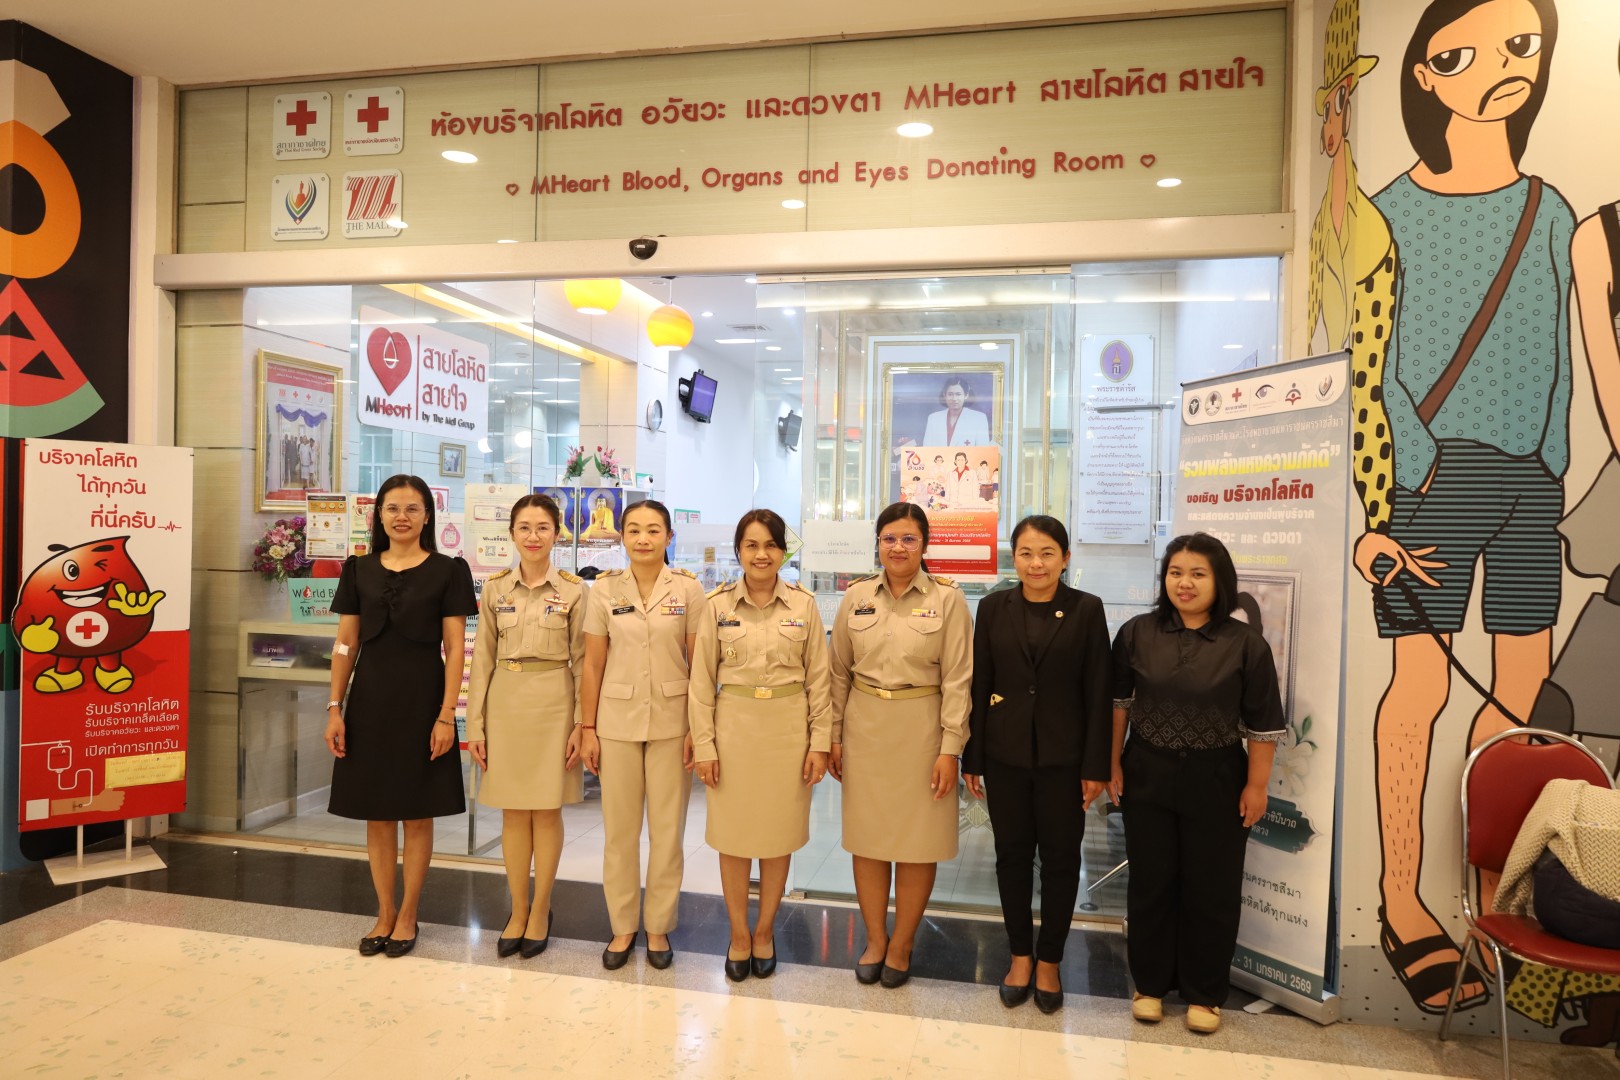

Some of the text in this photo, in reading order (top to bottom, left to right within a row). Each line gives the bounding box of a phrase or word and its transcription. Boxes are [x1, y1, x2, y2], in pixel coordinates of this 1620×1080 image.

[430, 56, 1265, 137] ห้องบริจาคโลหิต อวัยวะ และดวงตา MHeart สายโลหิต สายใจ
[530, 146, 1124, 196] MHeart Blood, Organs and Eyes Donating Room
[346, 221, 364, 231] THE
[422, 347, 486, 383] สายโลหิต
[365, 394, 412, 420] MHeart
[421, 383, 468, 412] สายใจ
[421, 411, 431, 423] by
[433, 413, 444, 424] The
[457, 418, 476, 431] Group
[39, 447, 138, 469] บริจาคโลหิต
[76, 473, 147, 499] ได้ทุกวัน
[1186, 477, 1314, 505] ขอเชิญ บริจาคโลหิต
[90, 503, 156, 529] ที่นี่ครับ
[1240, 533, 1257, 545] และ
[1262, 531, 1303, 545] ดวงตา
[85, 696, 180, 717] รับบริจาคโลหิต
[84, 723, 180, 738] รับบริจาคอวัยวะ และดวงตา
[85, 712, 180, 728] รับบริจาคเกล็ดเลือด
[85, 738, 179, 757] เปิดทำการทุกวัน
[1241, 871, 1302, 900] นครราชสีมา
[1243, 955, 1252, 970] 31
[1256, 962, 1287, 984] มกราคม
[1290, 974, 1312, 994] 2569
